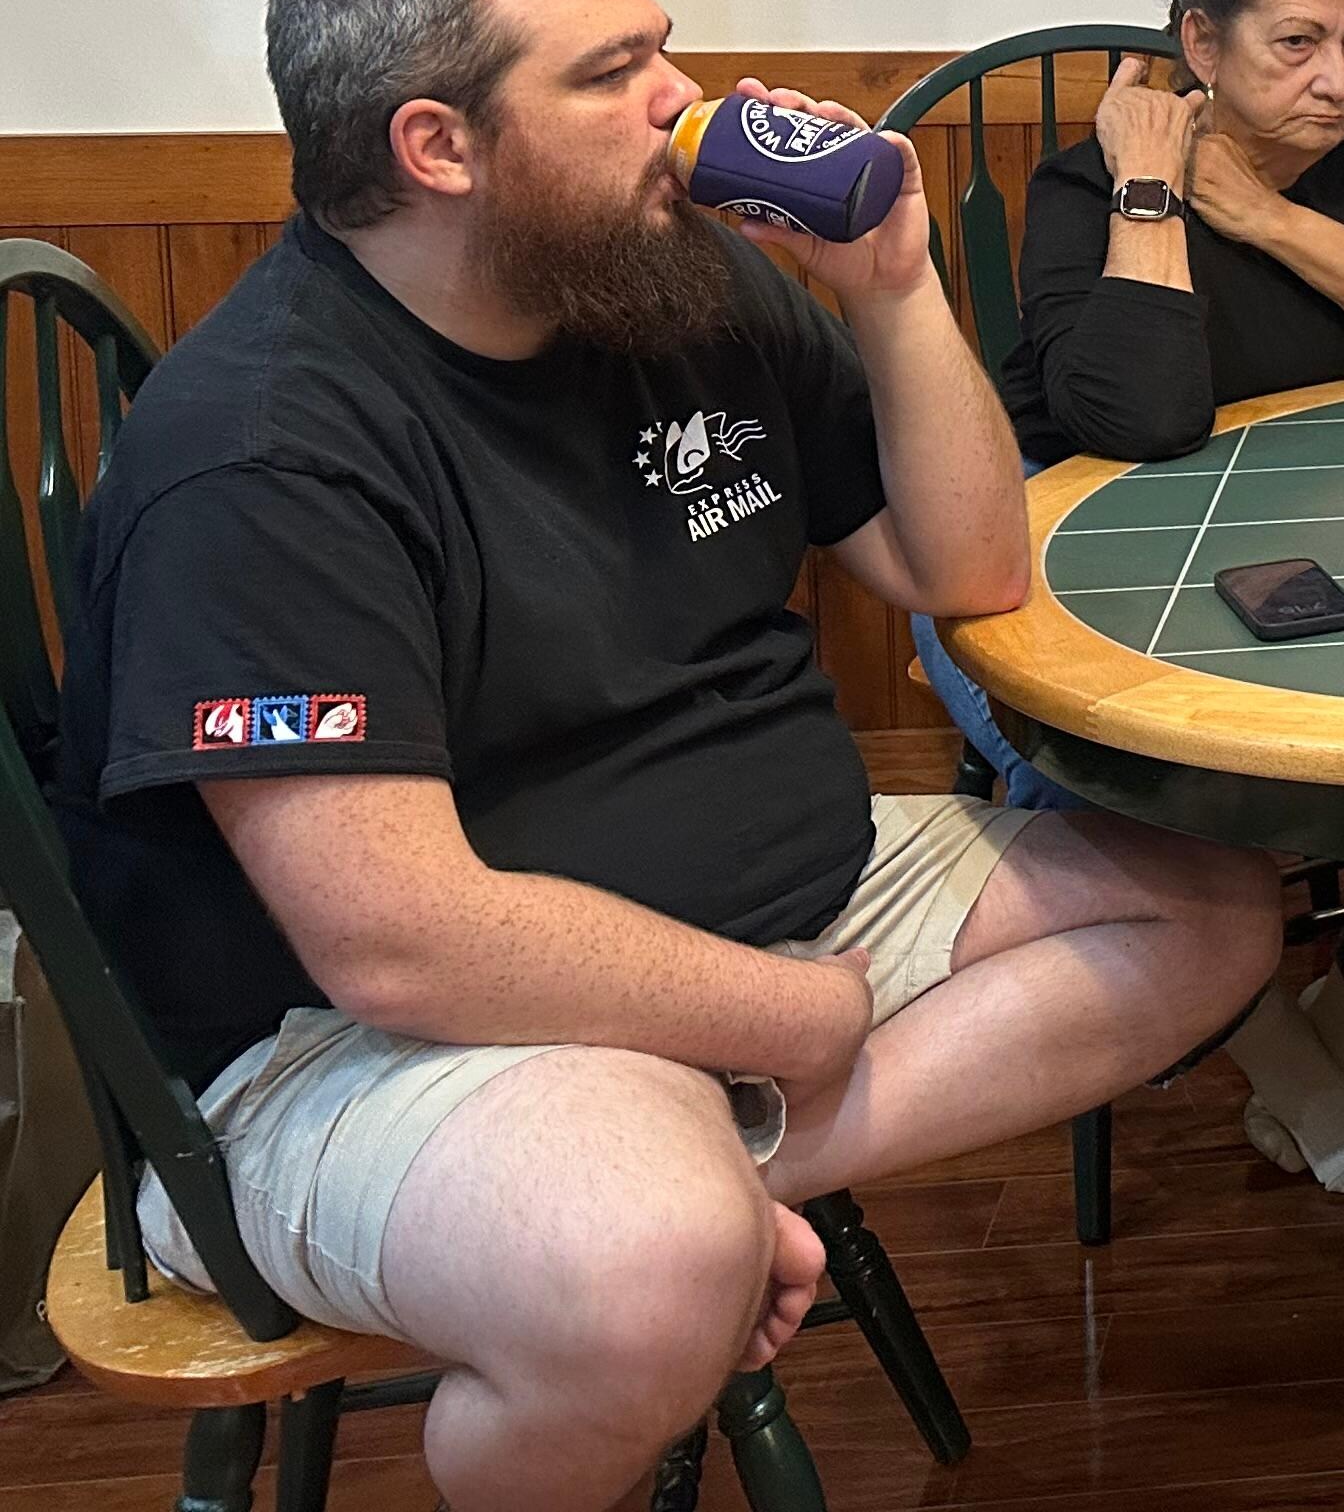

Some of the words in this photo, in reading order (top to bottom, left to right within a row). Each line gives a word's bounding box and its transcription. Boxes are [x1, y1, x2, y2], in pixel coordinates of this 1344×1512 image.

[687, 473, 761, 516] EXPRESS
[687, 507, 729, 542] AIR
[726, 481, 783, 522] MAIL
